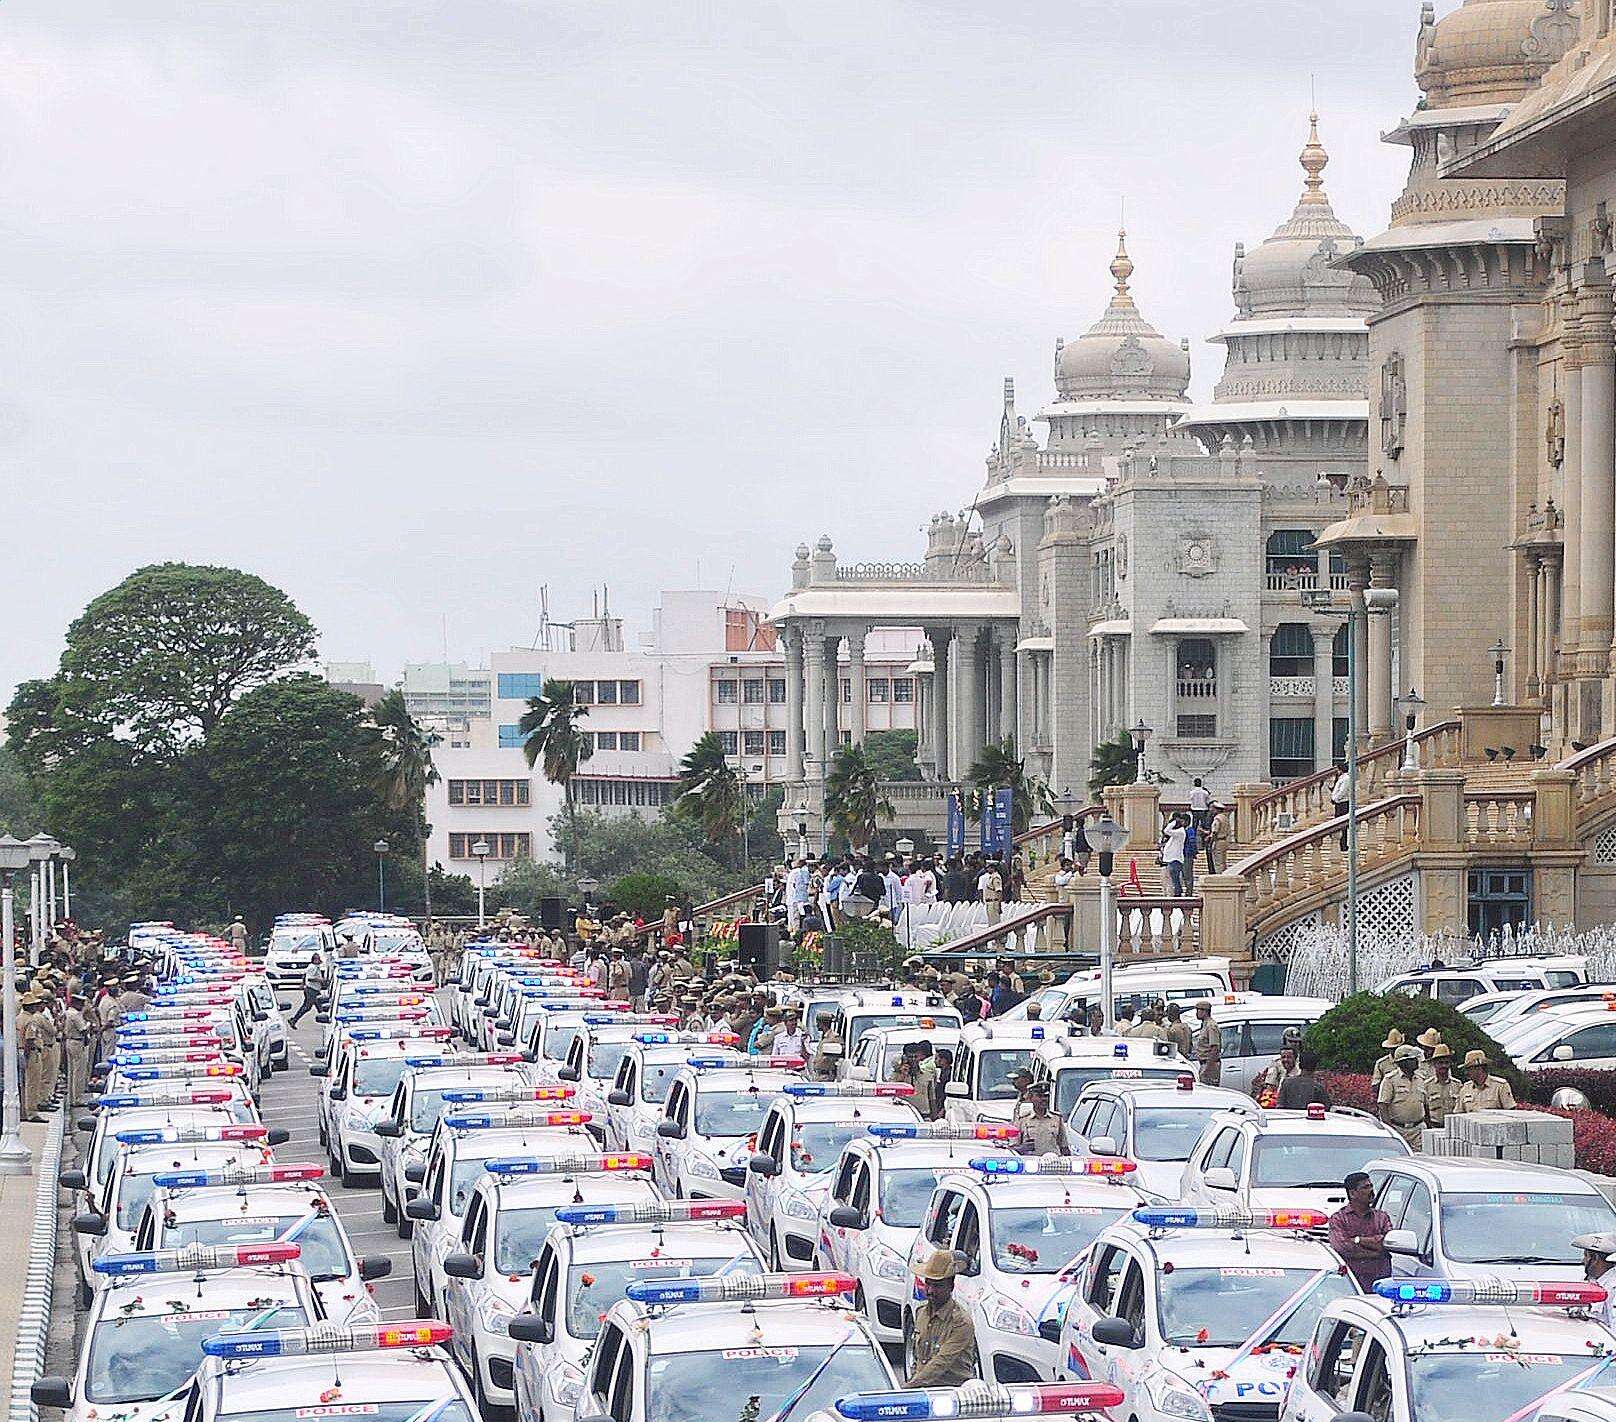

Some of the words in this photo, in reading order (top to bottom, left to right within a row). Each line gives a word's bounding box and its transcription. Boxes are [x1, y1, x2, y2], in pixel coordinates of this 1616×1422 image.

[164, 1312, 228, 1323] POLICE
[725, 1349, 795, 1359] POLICE
[299, 1405, 374, 1416] POLICE
